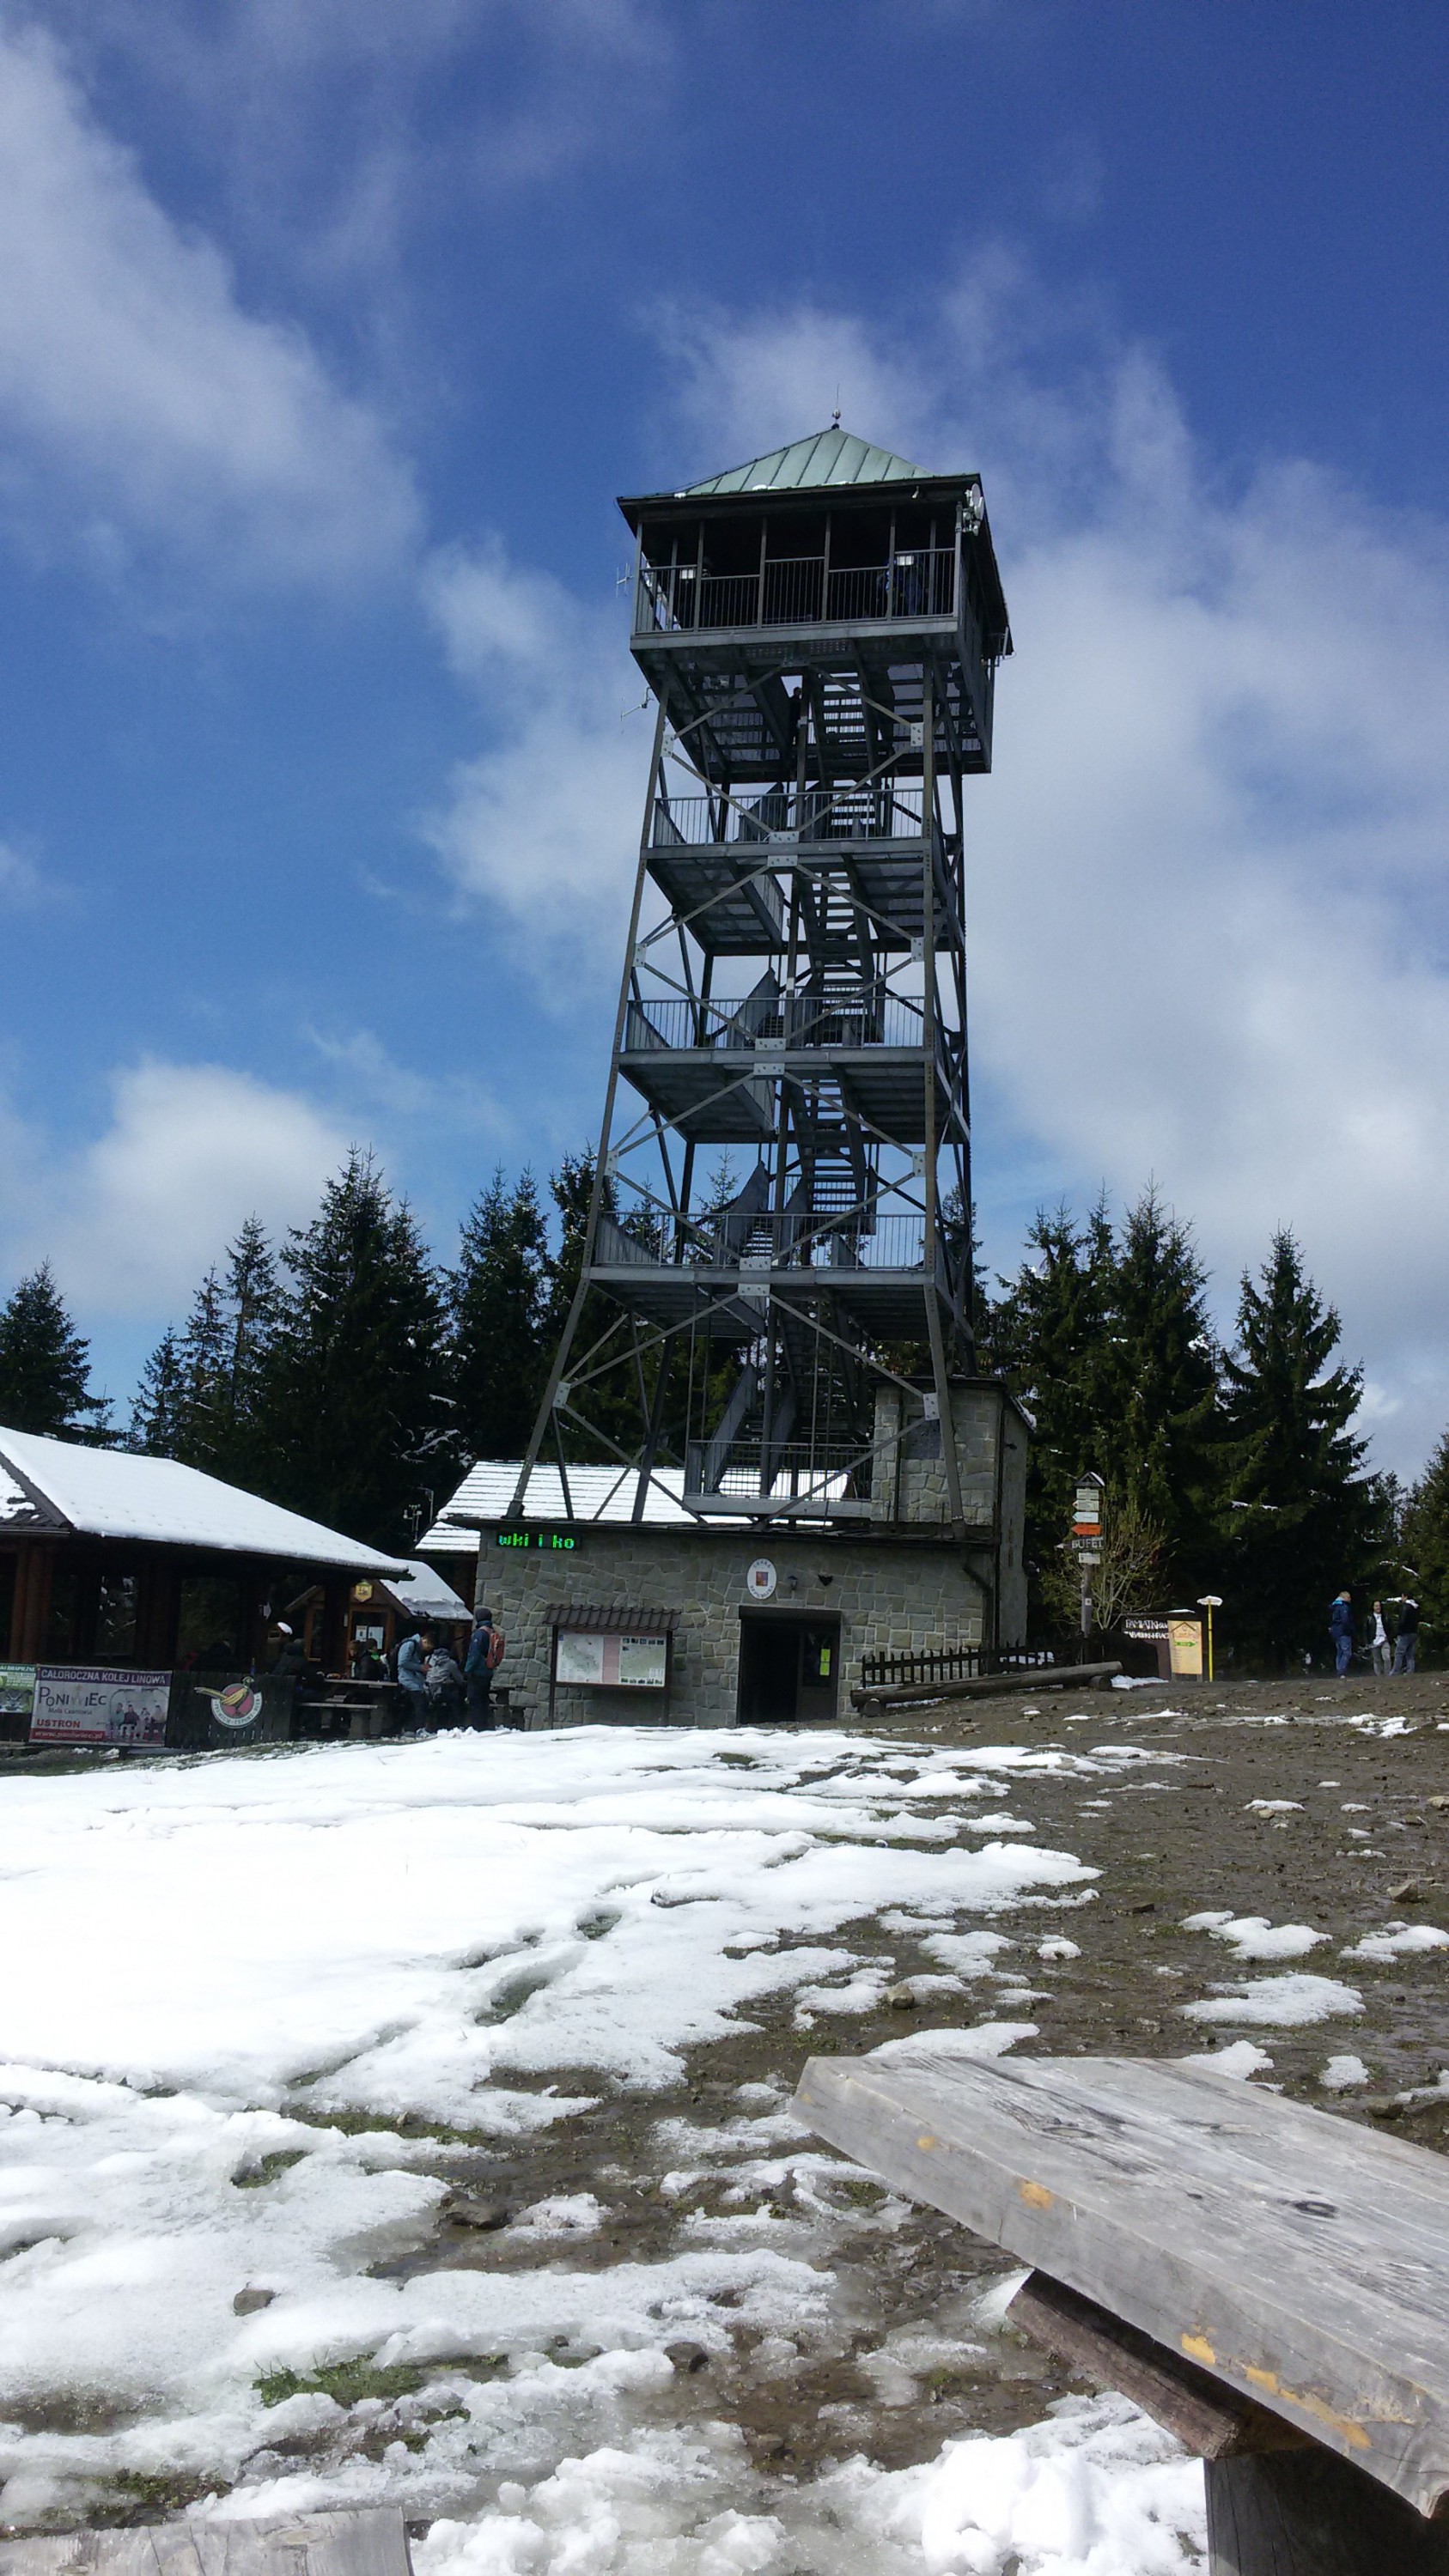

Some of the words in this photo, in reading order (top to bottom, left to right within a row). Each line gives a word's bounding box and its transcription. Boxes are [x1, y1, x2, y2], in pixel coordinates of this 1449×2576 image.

[498, 1533, 529, 1546] wki
[41, 1668, 100, 1681] CAŁOROCZNA
[101, 1672, 130, 1683] KOLEJ
[131, 1674, 166, 1685] LINOWA
[35, 1730, 103, 1741] www.poniwiec.pl
